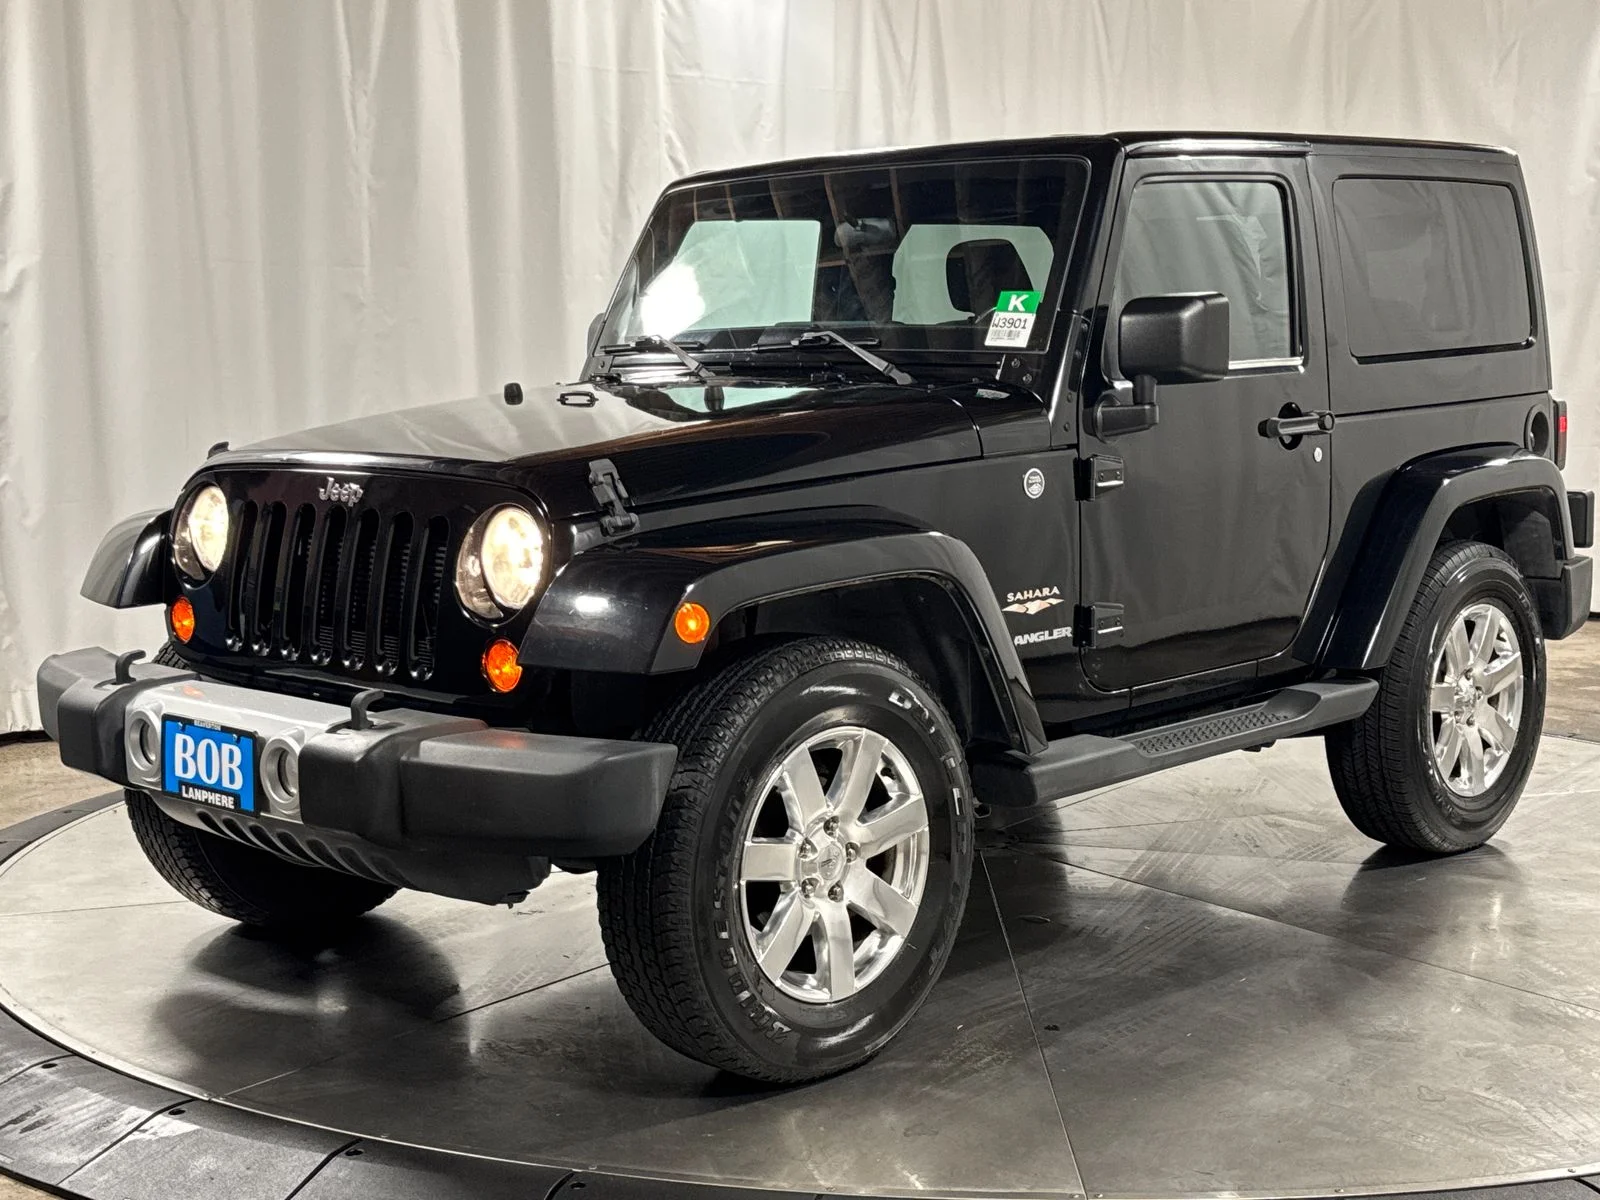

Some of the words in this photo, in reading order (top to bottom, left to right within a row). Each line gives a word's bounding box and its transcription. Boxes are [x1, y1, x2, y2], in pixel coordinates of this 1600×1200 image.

[1007, 294, 1030, 312] K
[991, 317, 1028, 330] W3901
[318, 476, 364, 508] Jeep
[1006, 585, 1061, 602] SAHARA
[1013, 626, 1073, 646] ANGLER
[174, 732, 244, 791] BOB
[181, 785, 236, 810] LANPHERE
